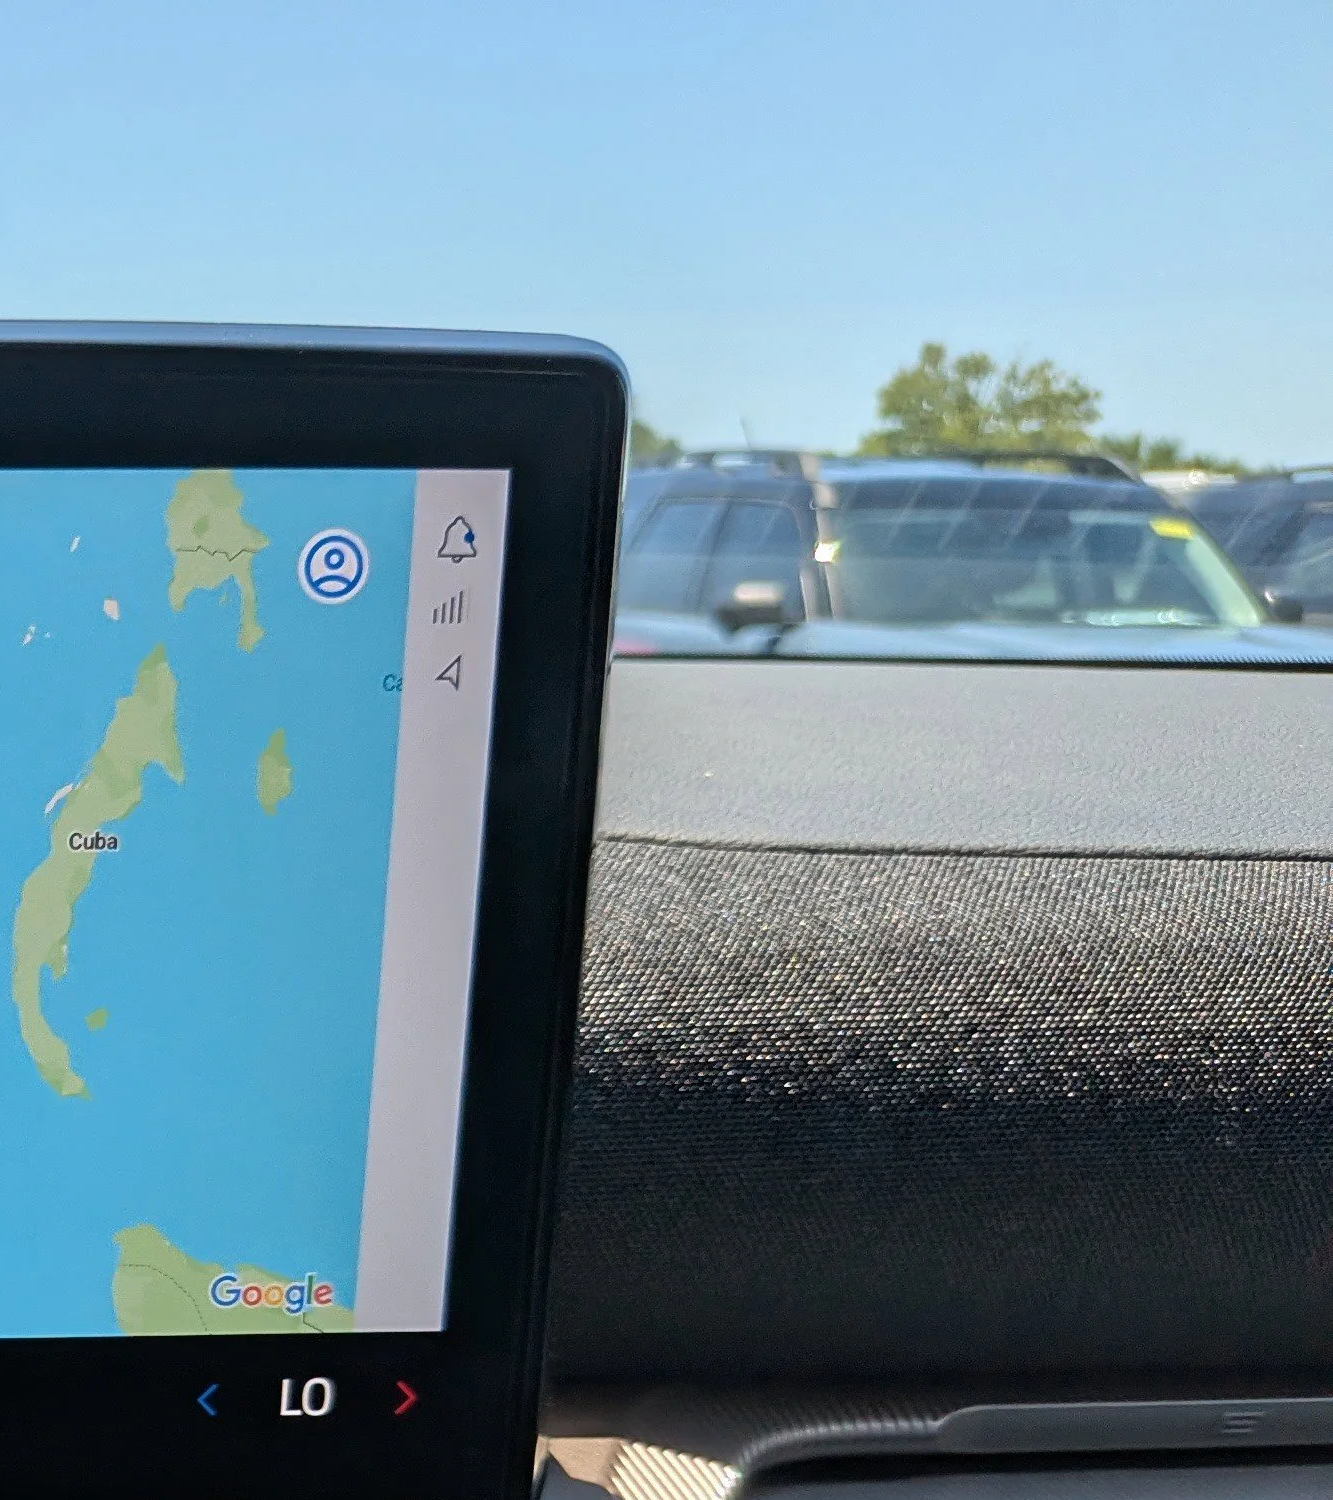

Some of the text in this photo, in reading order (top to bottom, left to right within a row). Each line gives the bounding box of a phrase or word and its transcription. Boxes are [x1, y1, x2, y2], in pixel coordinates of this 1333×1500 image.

[68, 830, 119, 852] Cuba
[209, 1272, 334, 1316] Google
[279, 1376, 336, 1417] LO
